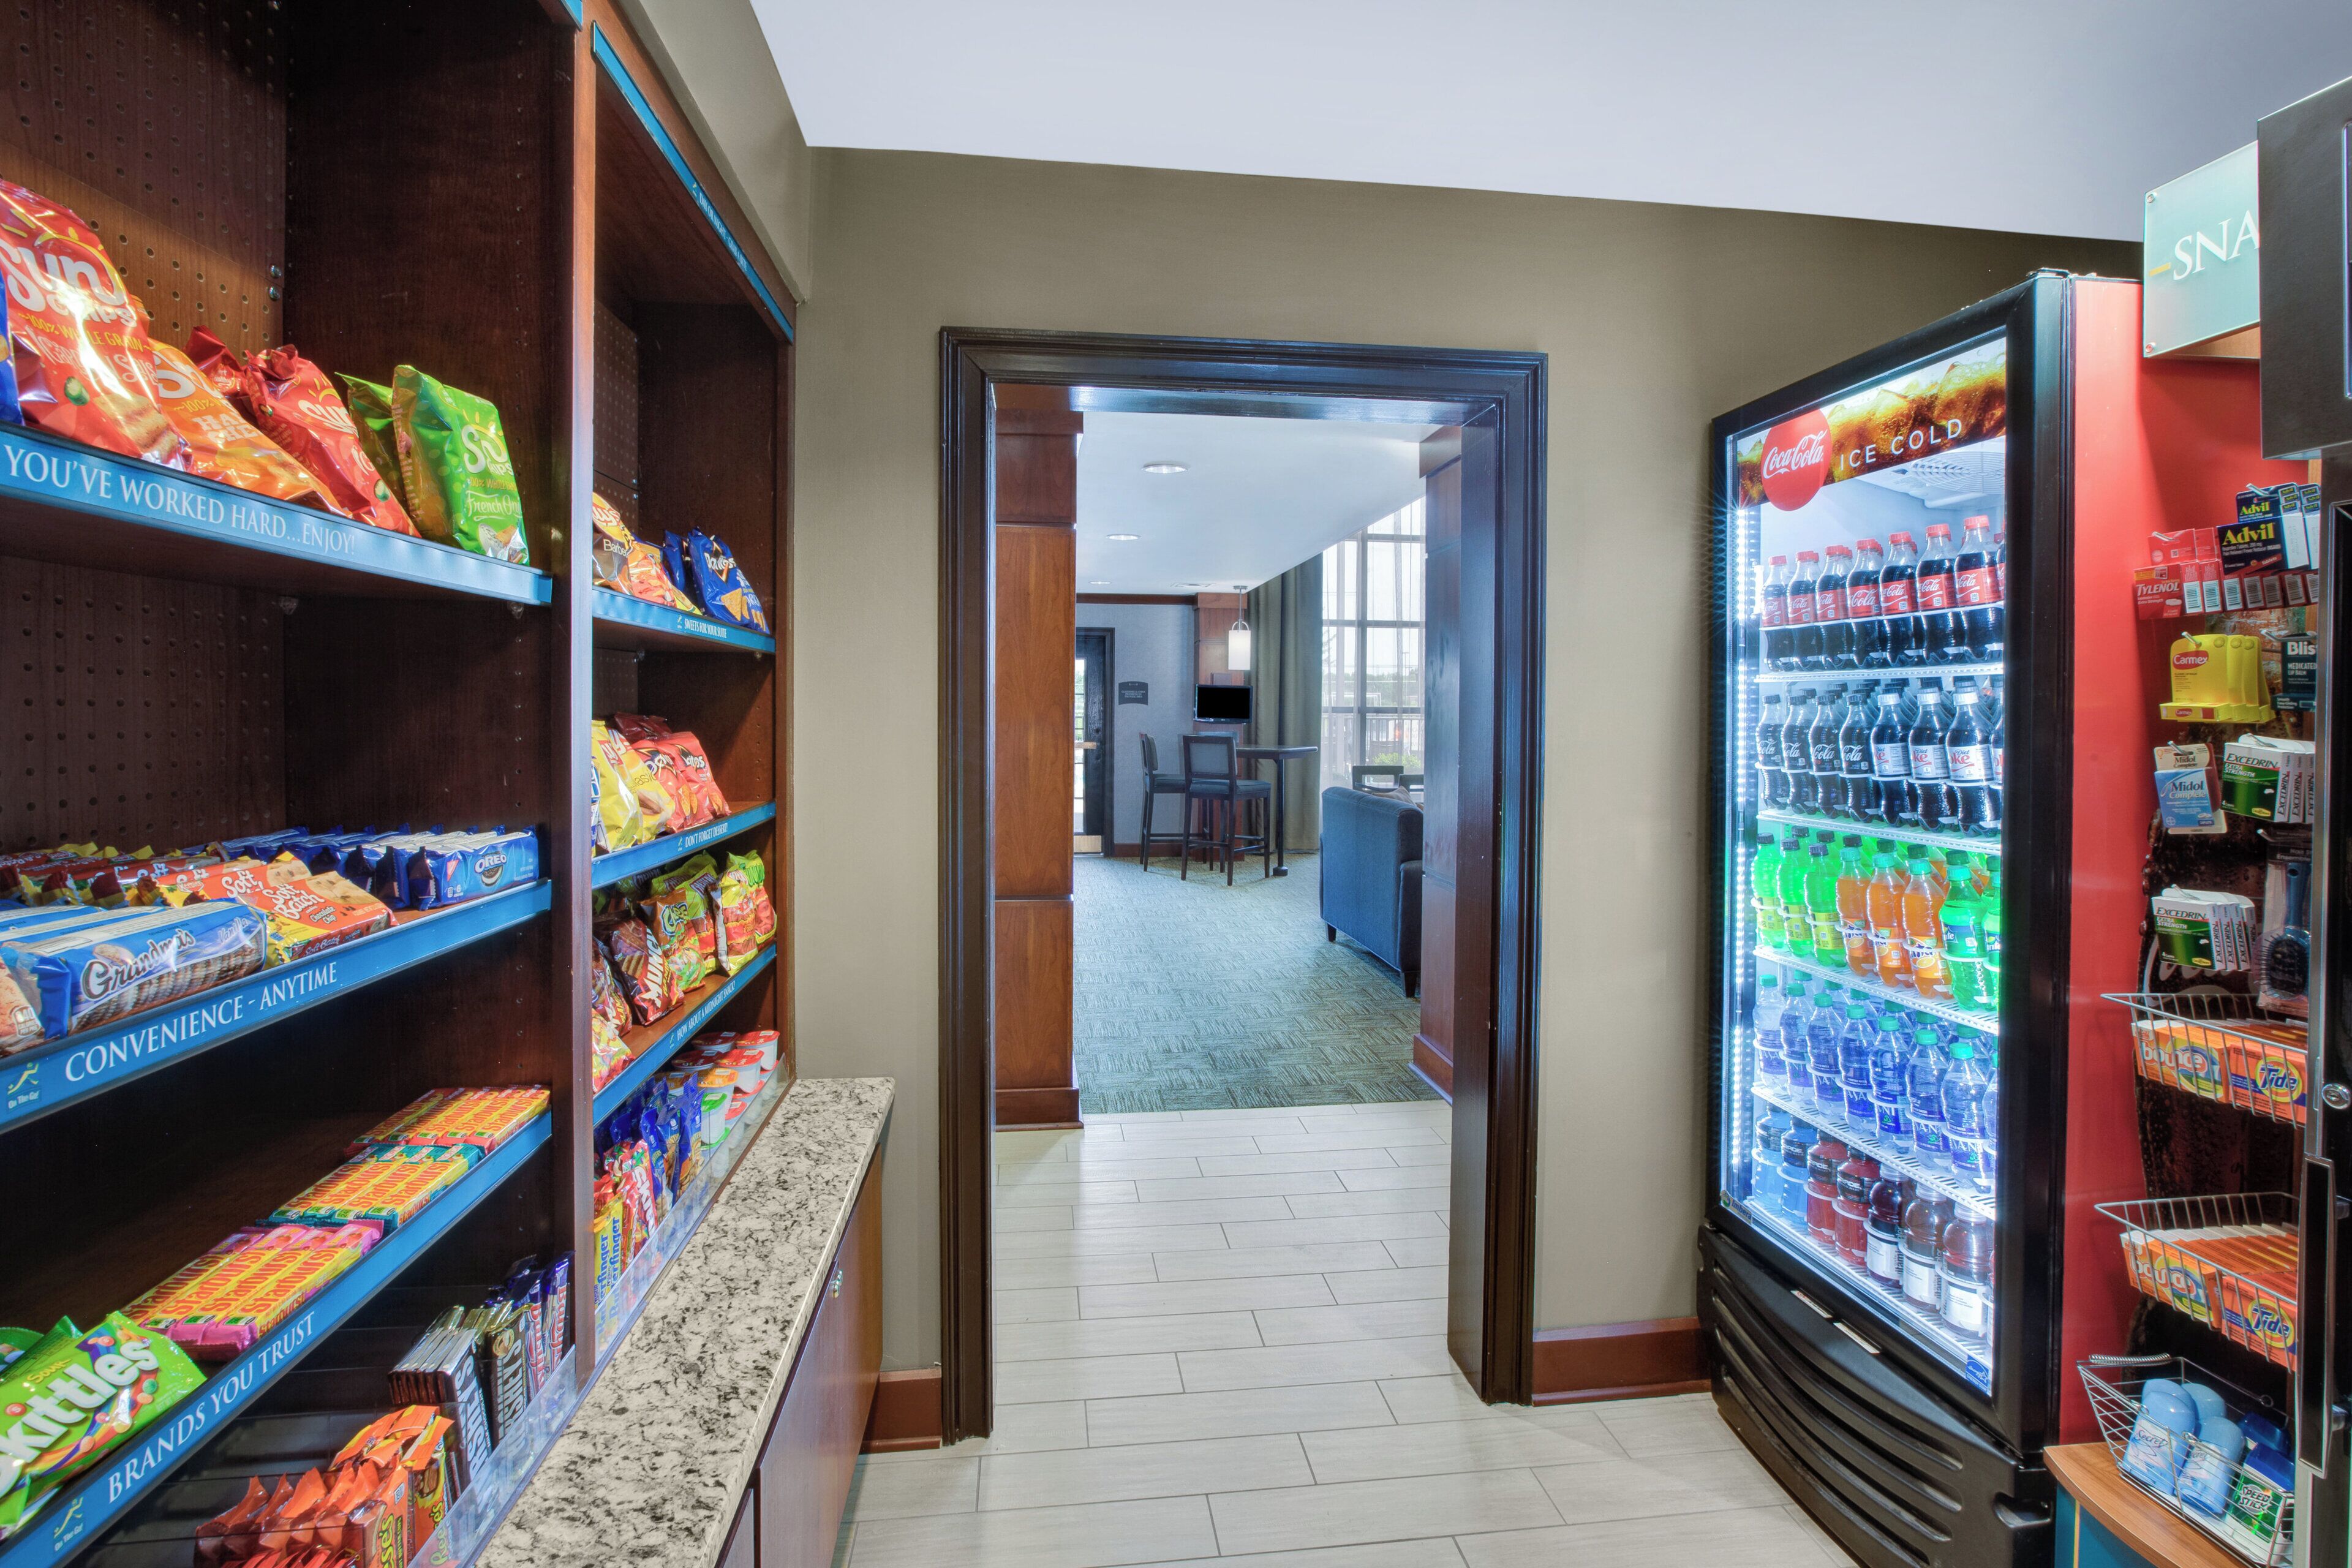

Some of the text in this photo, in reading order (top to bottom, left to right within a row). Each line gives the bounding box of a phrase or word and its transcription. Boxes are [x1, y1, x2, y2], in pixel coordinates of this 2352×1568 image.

[2173, 210, 2260, 281] SNA
[1763, 428, 1828, 480] Coca-Cola
[1839, 418, 1962, 471] ICE COLD
[4, 445, 113, 500] YOU'VE
[119, 475, 224, 526] WORKED
[465, 492, 502, 517] French
[2239, 502, 2270, 516] Advil
[2222, 522, 2275, 545] Advil
[2136, 582, 2180, 597] TYLENOL
[684, 618, 727, 638] SWEETS FOR YOUR SUITE
[2173, 654, 2208, 665] Carmex
[2224, 769, 2255, 778] STRENGTH
[2226, 753, 2278, 768] EXCEDRIN
[2169, 790, 2206, 799] Complete
[2171, 781, 2204, 791] Midol
[2277, 773, 2289, 815] EXCEDRIN
[2292, 774, 2302, 817] EXCEDRIN
[685, 833, 698, 848] DON'T
[698, 827, 713, 843] FORGET
[474, 853, 507, 874] OREO
[262, 883, 301, 905] Soft
[273, 890, 326, 921] Batch
[309, 906, 337, 923] Chocolate
[322, 914, 337, 924] Chip
[2157, 907, 2206, 919] EXCEDRIN
[218, 917, 249, 944] Vanilla
[2212, 924, 2223, 963] EXCEDRIN
[2224, 924, 2233, 963] EXCEDRIN
[2236, 923, 2247, 963] EXCEDRIN
[81, 928, 196, 1001] Grandma's
[65, 995, 244, 1082] CONVENIENCE
[259, 962, 338, 1011] ANYTIME
[677, 1022, 688, 1041] HOW
[688, 1010, 702, 1031] ABOUT
[704, 990, 724, 1016] MIDNIGHT
[2143, 1041, 2207, 1073] bounce
[2259, 1065, 2298, 1090] Tide
[483, 1099, 535, 1131] Starburst
[284, 1164, 364, 1209] Starburst
[320, 1164, 393, 1206] Starburst
[346, 1164, 421, 1208] Starburst
[380, 1164, 451, 1206] Starburst
[160, 1250, 268, 1316] Starburst
[199, 1251, 306, 1314] Starburst
[239, 1249, 340, 1313] Starburst
[258, 1292, 306, 1336] Starburst
[2252, 1306, 2291, 1338] Tide
[27, 1357, 72, 1385] Sour
[107, 1311, 315, 1504] BRANDS YOU TRUST
[2132, 1430, 2169, 1449] Secret
[2238, 1496, 2272, 1513] STICK
[2241, 1485, 2272, 1504] SPEED
